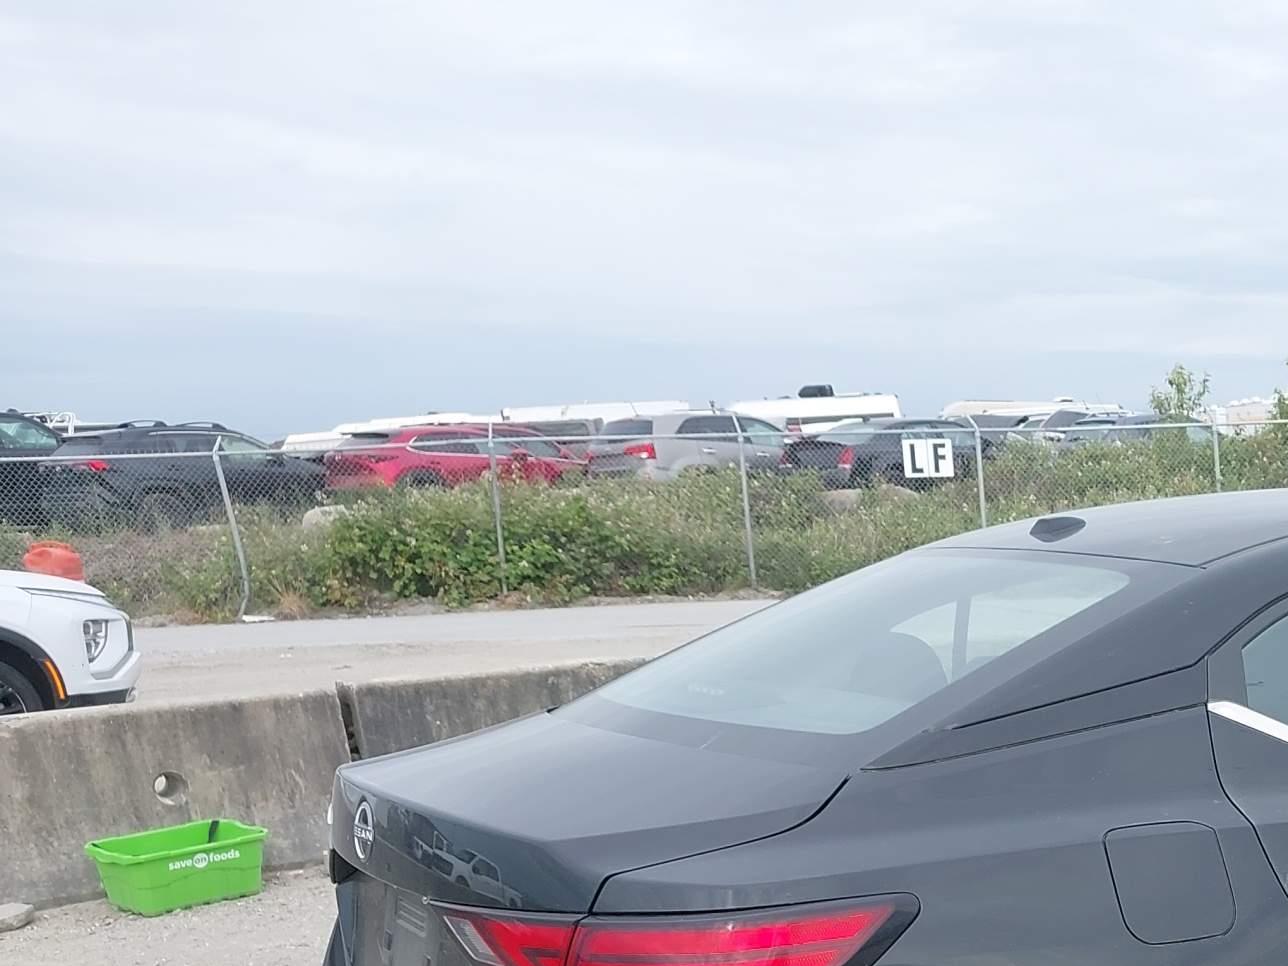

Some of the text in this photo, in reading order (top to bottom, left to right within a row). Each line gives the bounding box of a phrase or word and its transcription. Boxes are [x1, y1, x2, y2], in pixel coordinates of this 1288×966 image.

[353, 825, 374, 842] SSAN
[168, 859, 193, 871] save
[209, 849, 240, 863] foods
